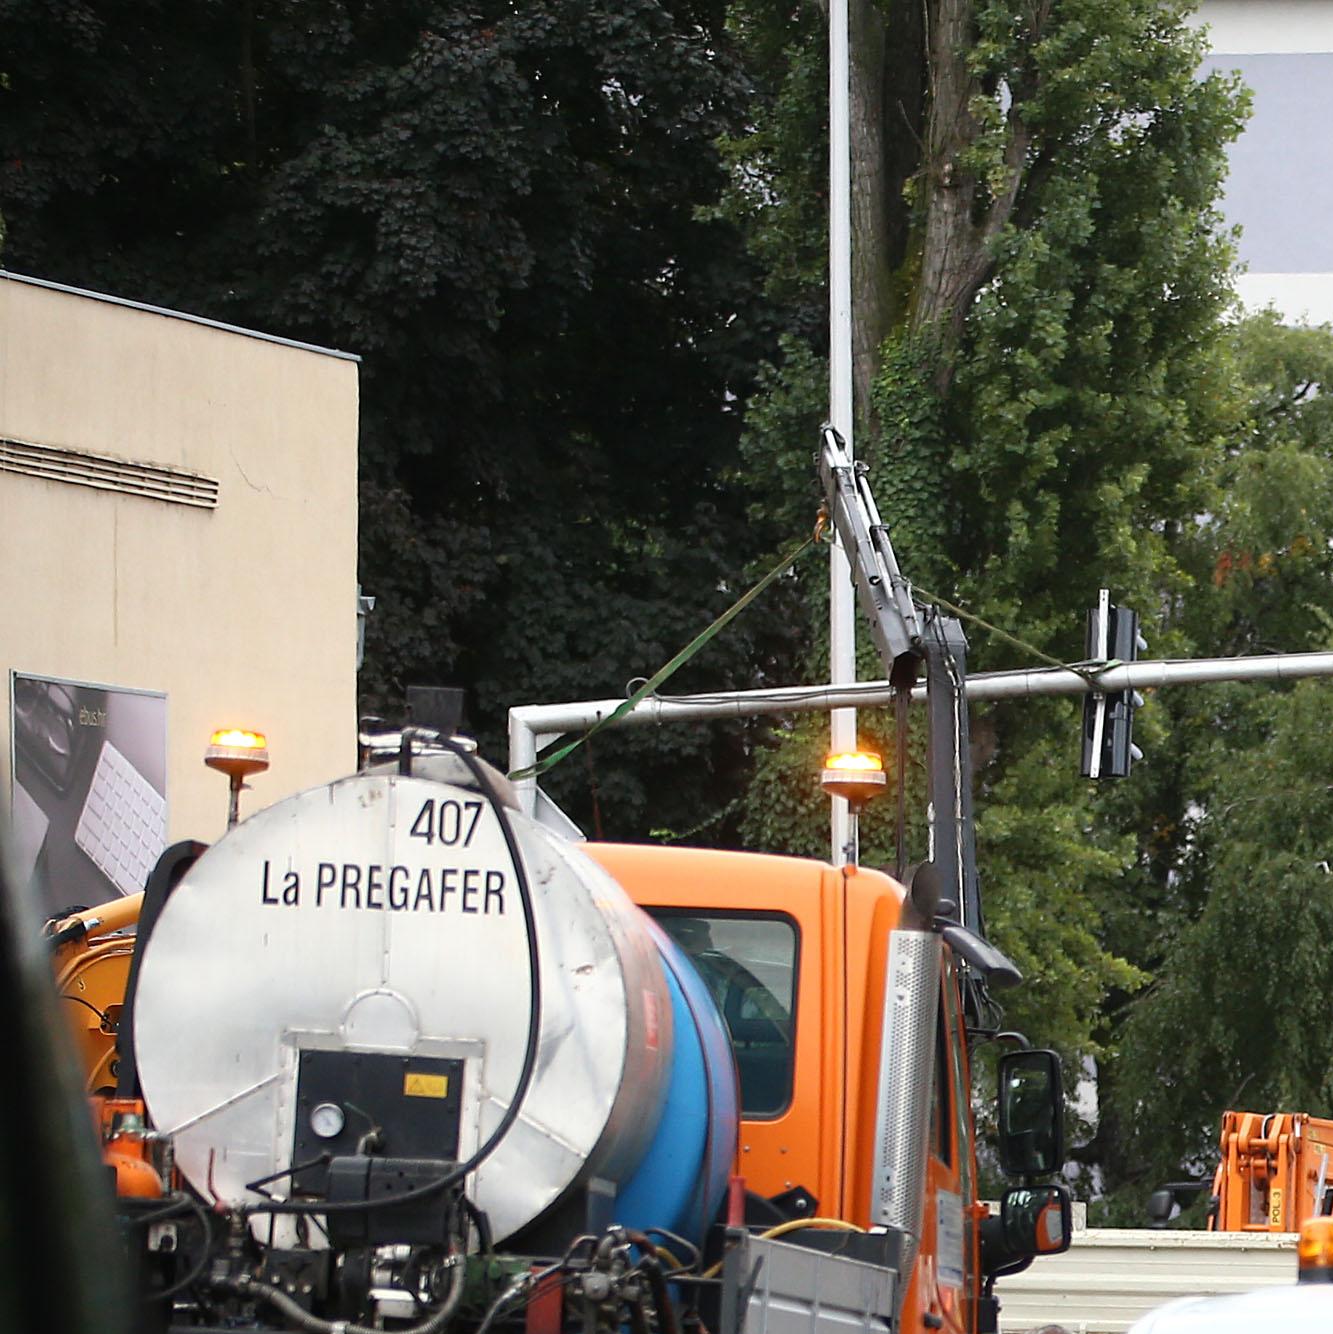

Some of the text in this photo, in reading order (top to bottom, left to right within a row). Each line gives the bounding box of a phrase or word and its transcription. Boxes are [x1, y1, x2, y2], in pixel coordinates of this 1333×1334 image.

[410, 799, 484, 847] 407
[263, 860, 506, 914] La PREGAFER
